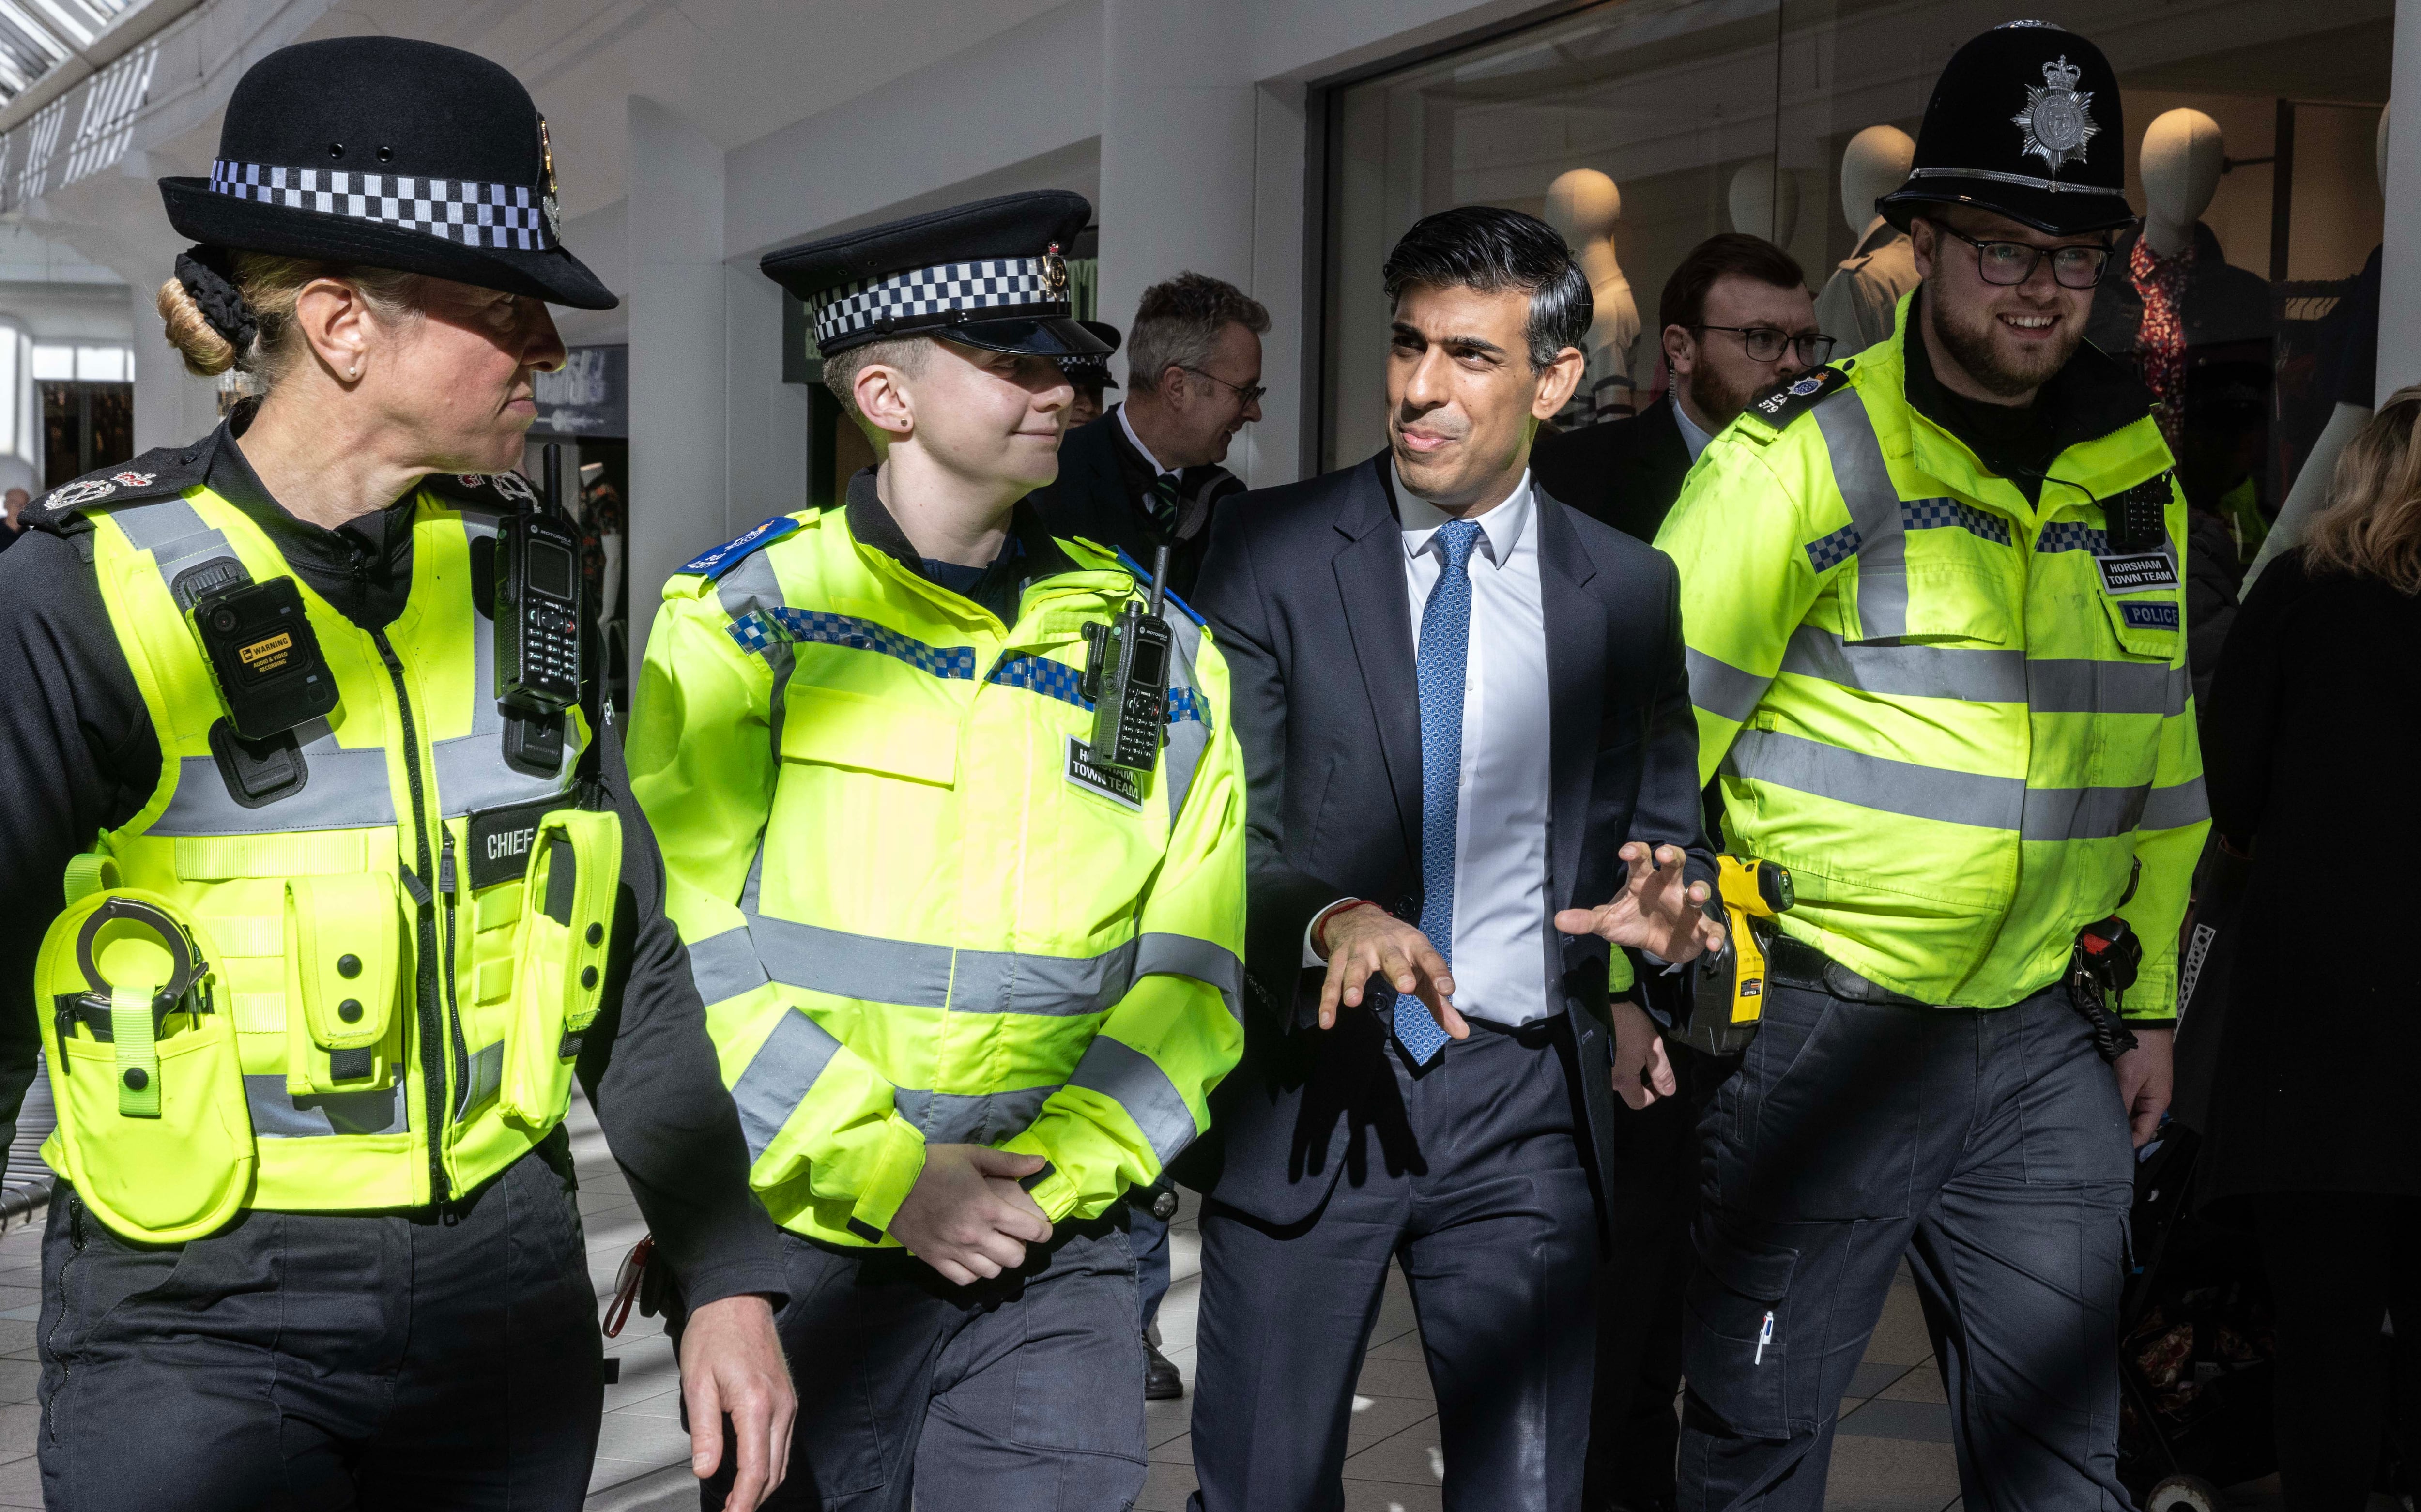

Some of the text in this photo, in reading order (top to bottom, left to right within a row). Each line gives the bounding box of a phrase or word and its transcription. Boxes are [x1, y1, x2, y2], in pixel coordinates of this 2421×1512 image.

[540, 530, 571, 543] MOTOROLA
[2110, 560, 2162, 573] HORSHAM
[2108, 571, 2173, 585] TOWN TEAM
[2131, 607, 2178, 624] POLICE
[1146, 630, 1167, 639] MOTOROLA
[253, 638, 288, 655] WARNING
[253, 658, 268, 668] AUDIO
[273, 651, 288, 660] VIDEO
[259, 659, 287, 673] RECORDING
[1073, 761, 1138, 799] TOWN TEAM
[487, 828, 534, 860] CHIEF
